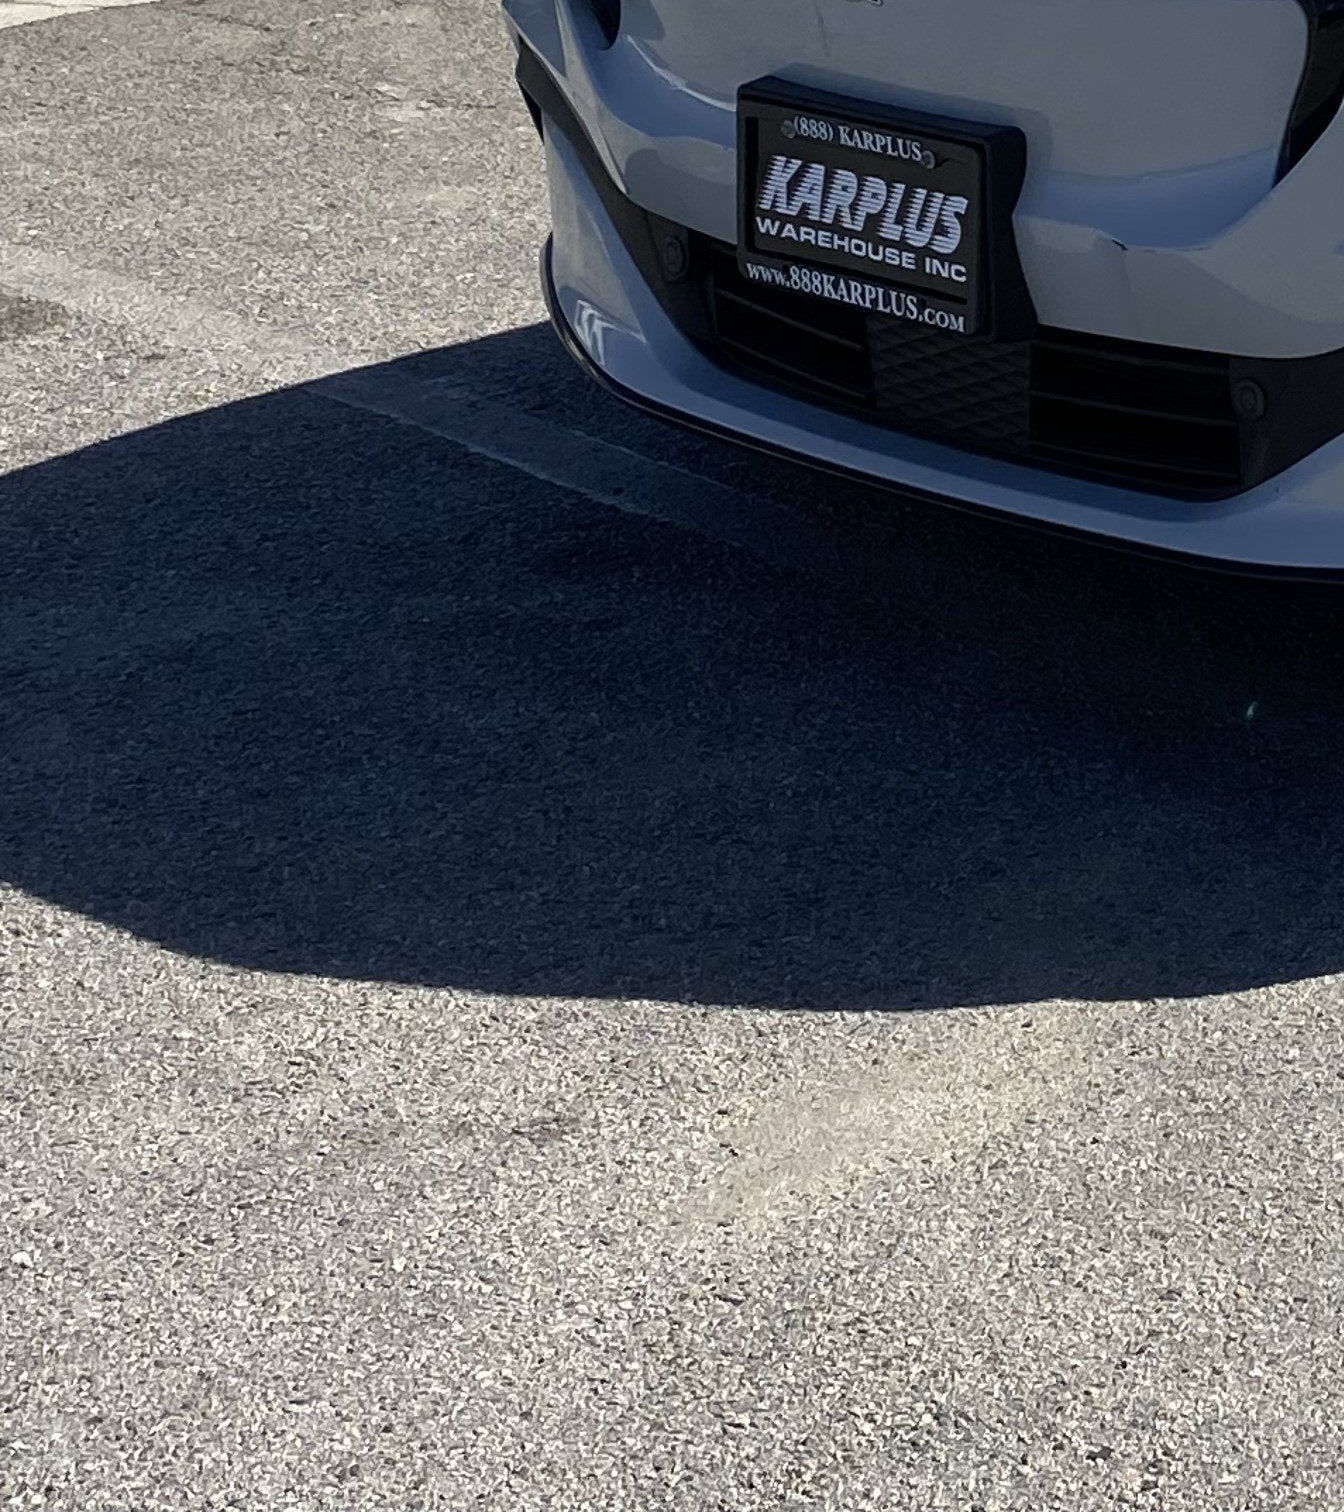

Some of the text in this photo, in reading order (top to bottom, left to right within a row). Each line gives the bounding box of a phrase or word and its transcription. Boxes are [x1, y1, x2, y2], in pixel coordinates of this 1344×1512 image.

[793, 115, 923, 162] (888) KARPLUS
[757, 153, 969, 255] KARPLUS
[755, 215, 968, 284] WAREHOUSE INC
